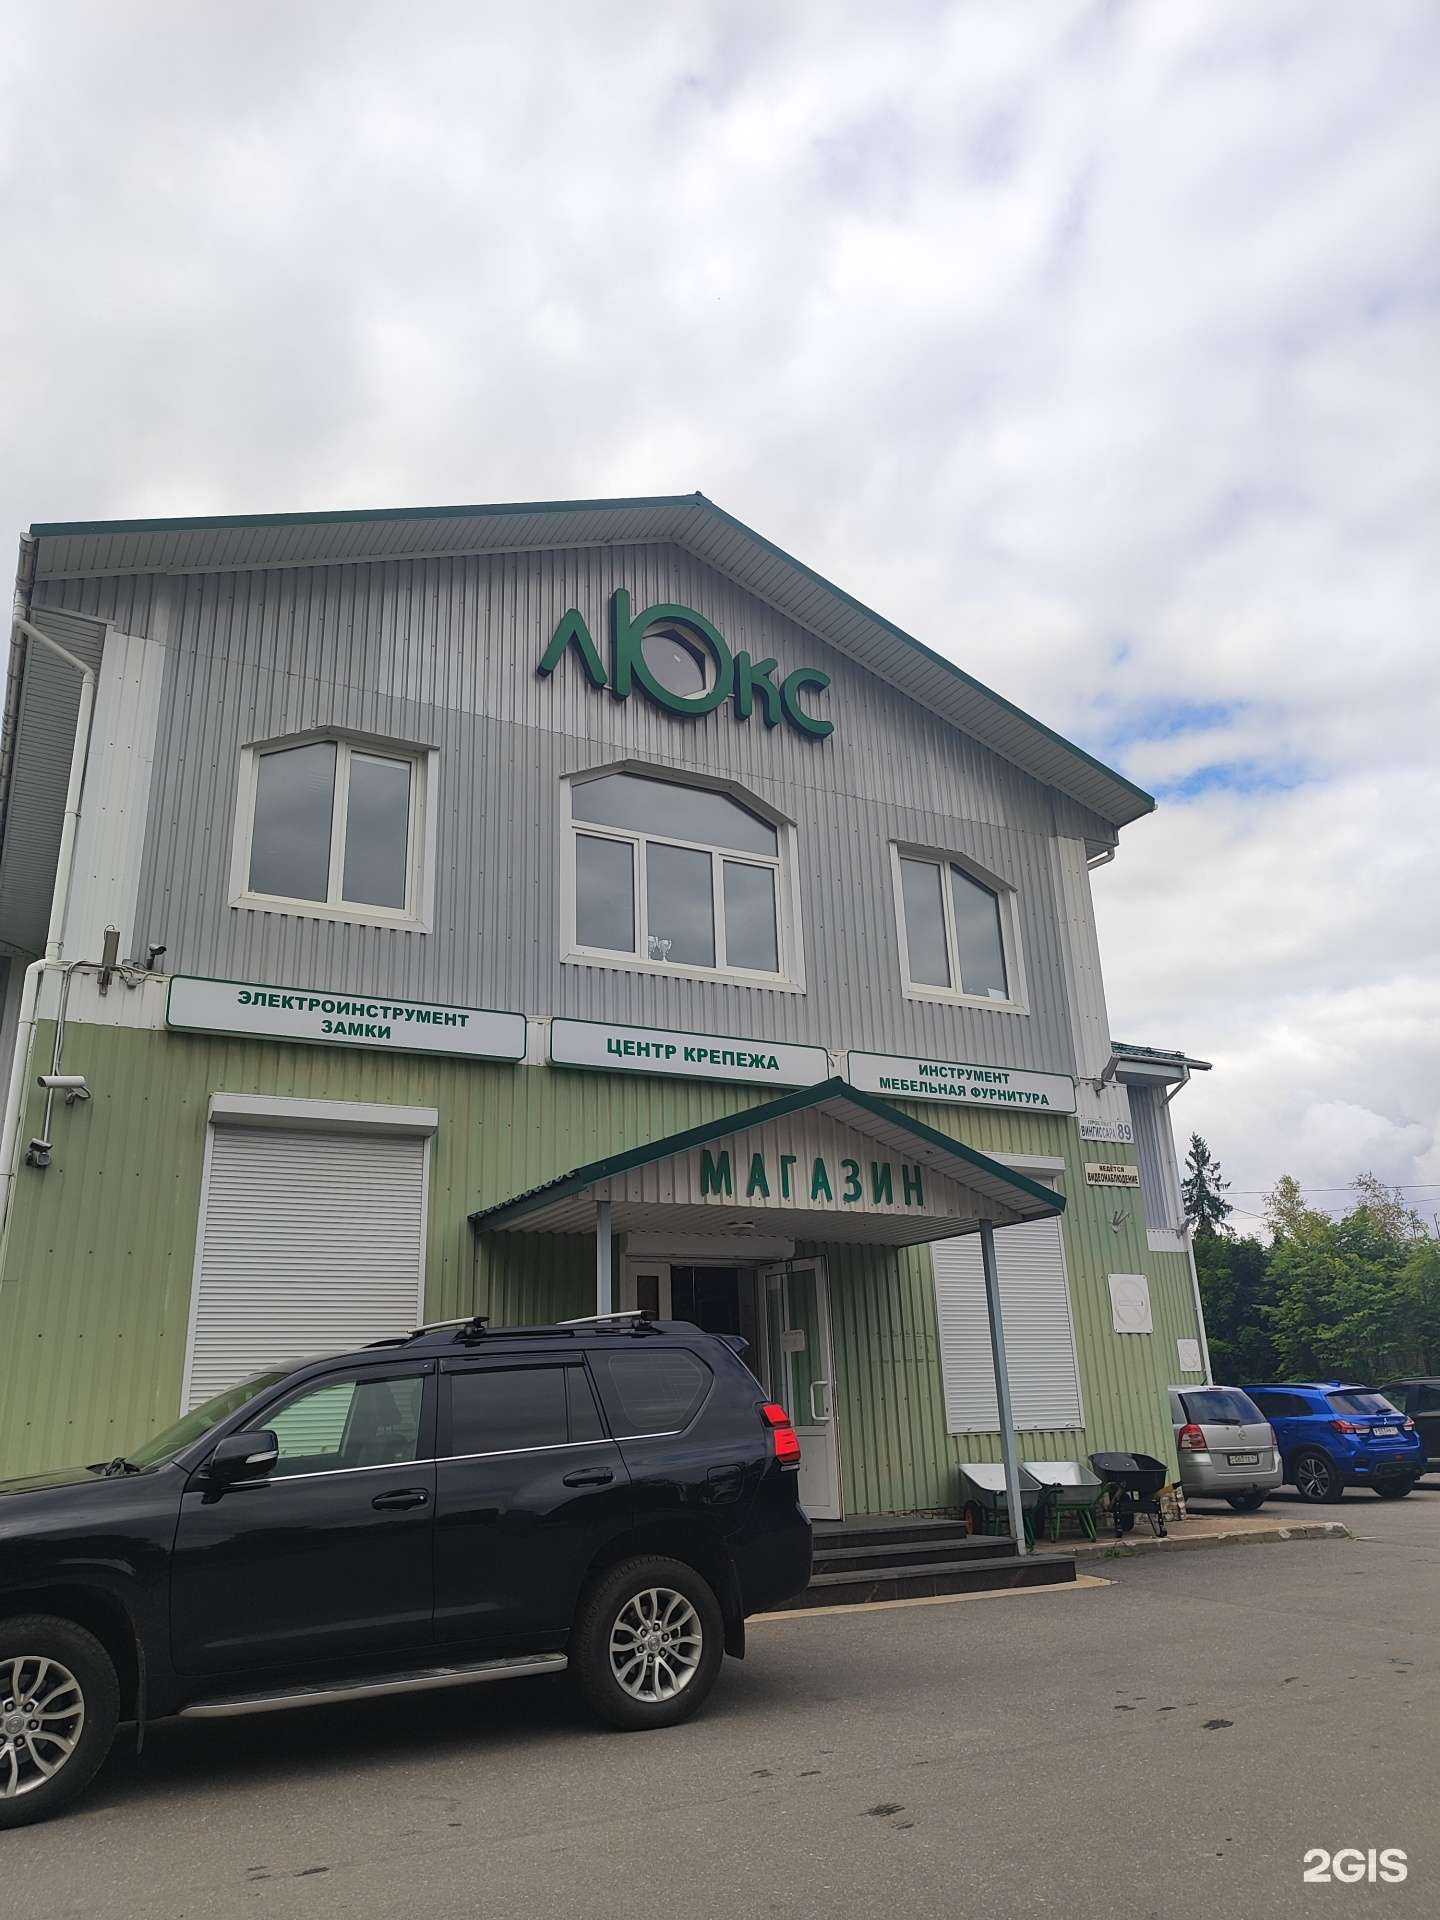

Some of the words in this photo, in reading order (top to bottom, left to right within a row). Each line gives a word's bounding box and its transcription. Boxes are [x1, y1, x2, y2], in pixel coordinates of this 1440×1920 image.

[237, 990, 470, 1027] ЭЛЕКТРОИНСТРУМЕНТ
[321, 1019, 392, 1040] ЗАМКИ
[606, 1038, 677, 1060] ЦЕНТР
[683, 1048, 780, 1071] КРЕПЕЖА
[918, 1064, 1010, 1085] ИНСТРУМЕНТ
[879, 1077, 967, 1097] МЕБЕЛЬНАЯ
[970, 1087, 1050, 1106] ФУРНИТУРА
[1117, 1123, 1132, 1141] 89
[700, 1149, 925, 1207] МАГАЗИН
